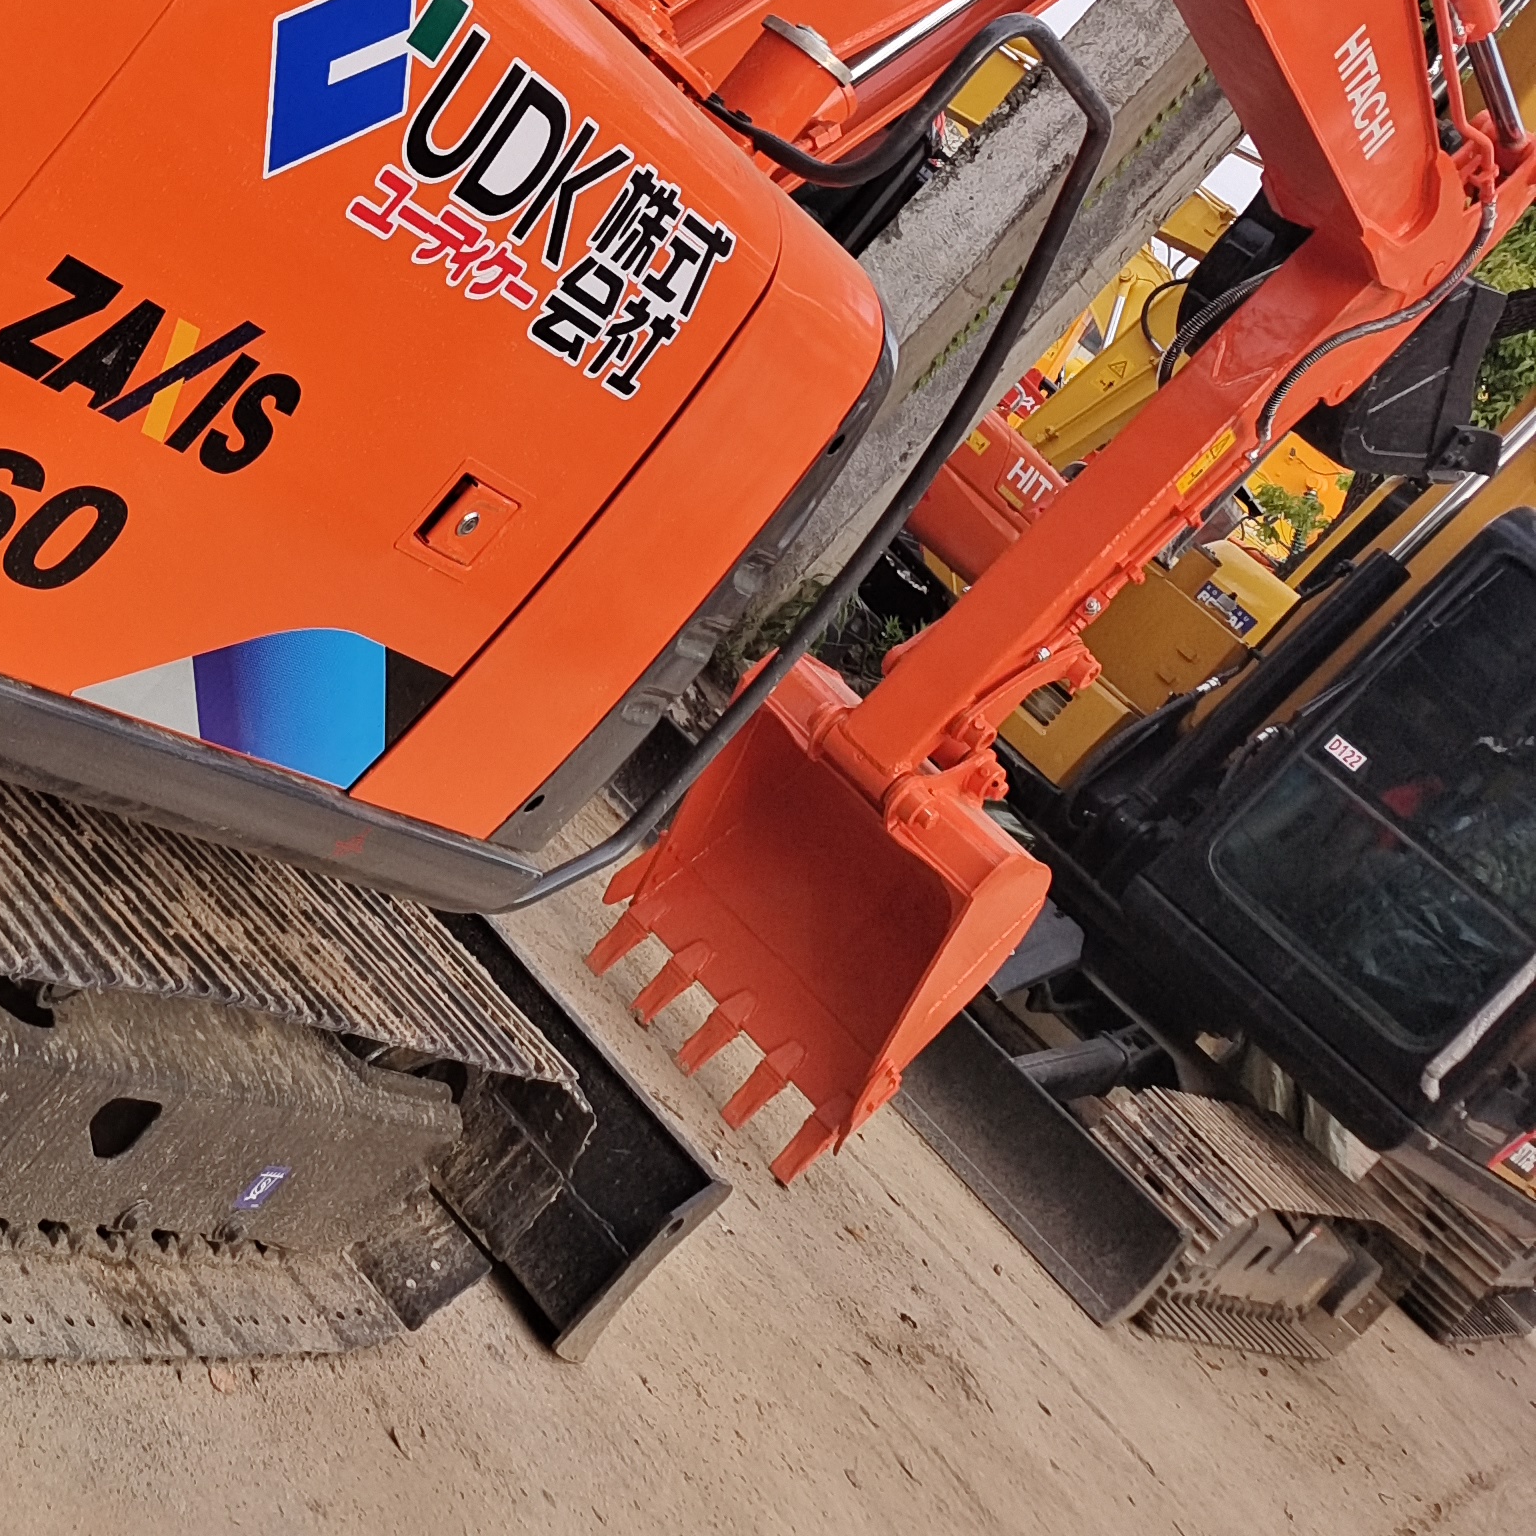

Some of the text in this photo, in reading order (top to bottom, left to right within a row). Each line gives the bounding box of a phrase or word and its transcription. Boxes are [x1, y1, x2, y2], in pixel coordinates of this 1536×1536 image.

[1333, 23, 1396, 161] HITACHI
[405, 29, 631, 267] UDK
[1006, 456, 1058, 503] HIT
[1328, 738, 1363, 769] D122
